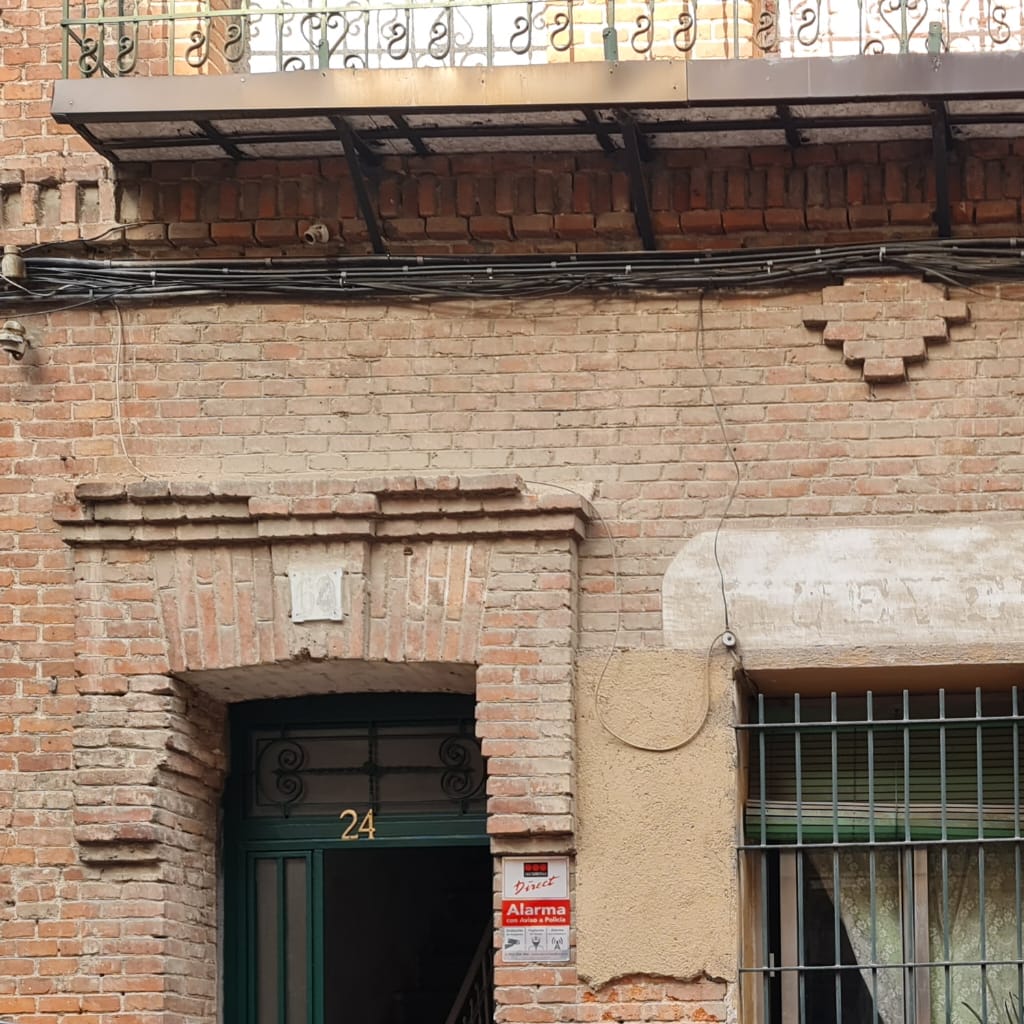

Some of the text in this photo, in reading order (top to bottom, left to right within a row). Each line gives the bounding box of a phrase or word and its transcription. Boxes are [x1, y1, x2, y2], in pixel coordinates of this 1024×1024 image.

[340, 808, 376, 840] 24
[513, 875, 560, 896] Direct
[506, 902, 566, 916] Alarma
